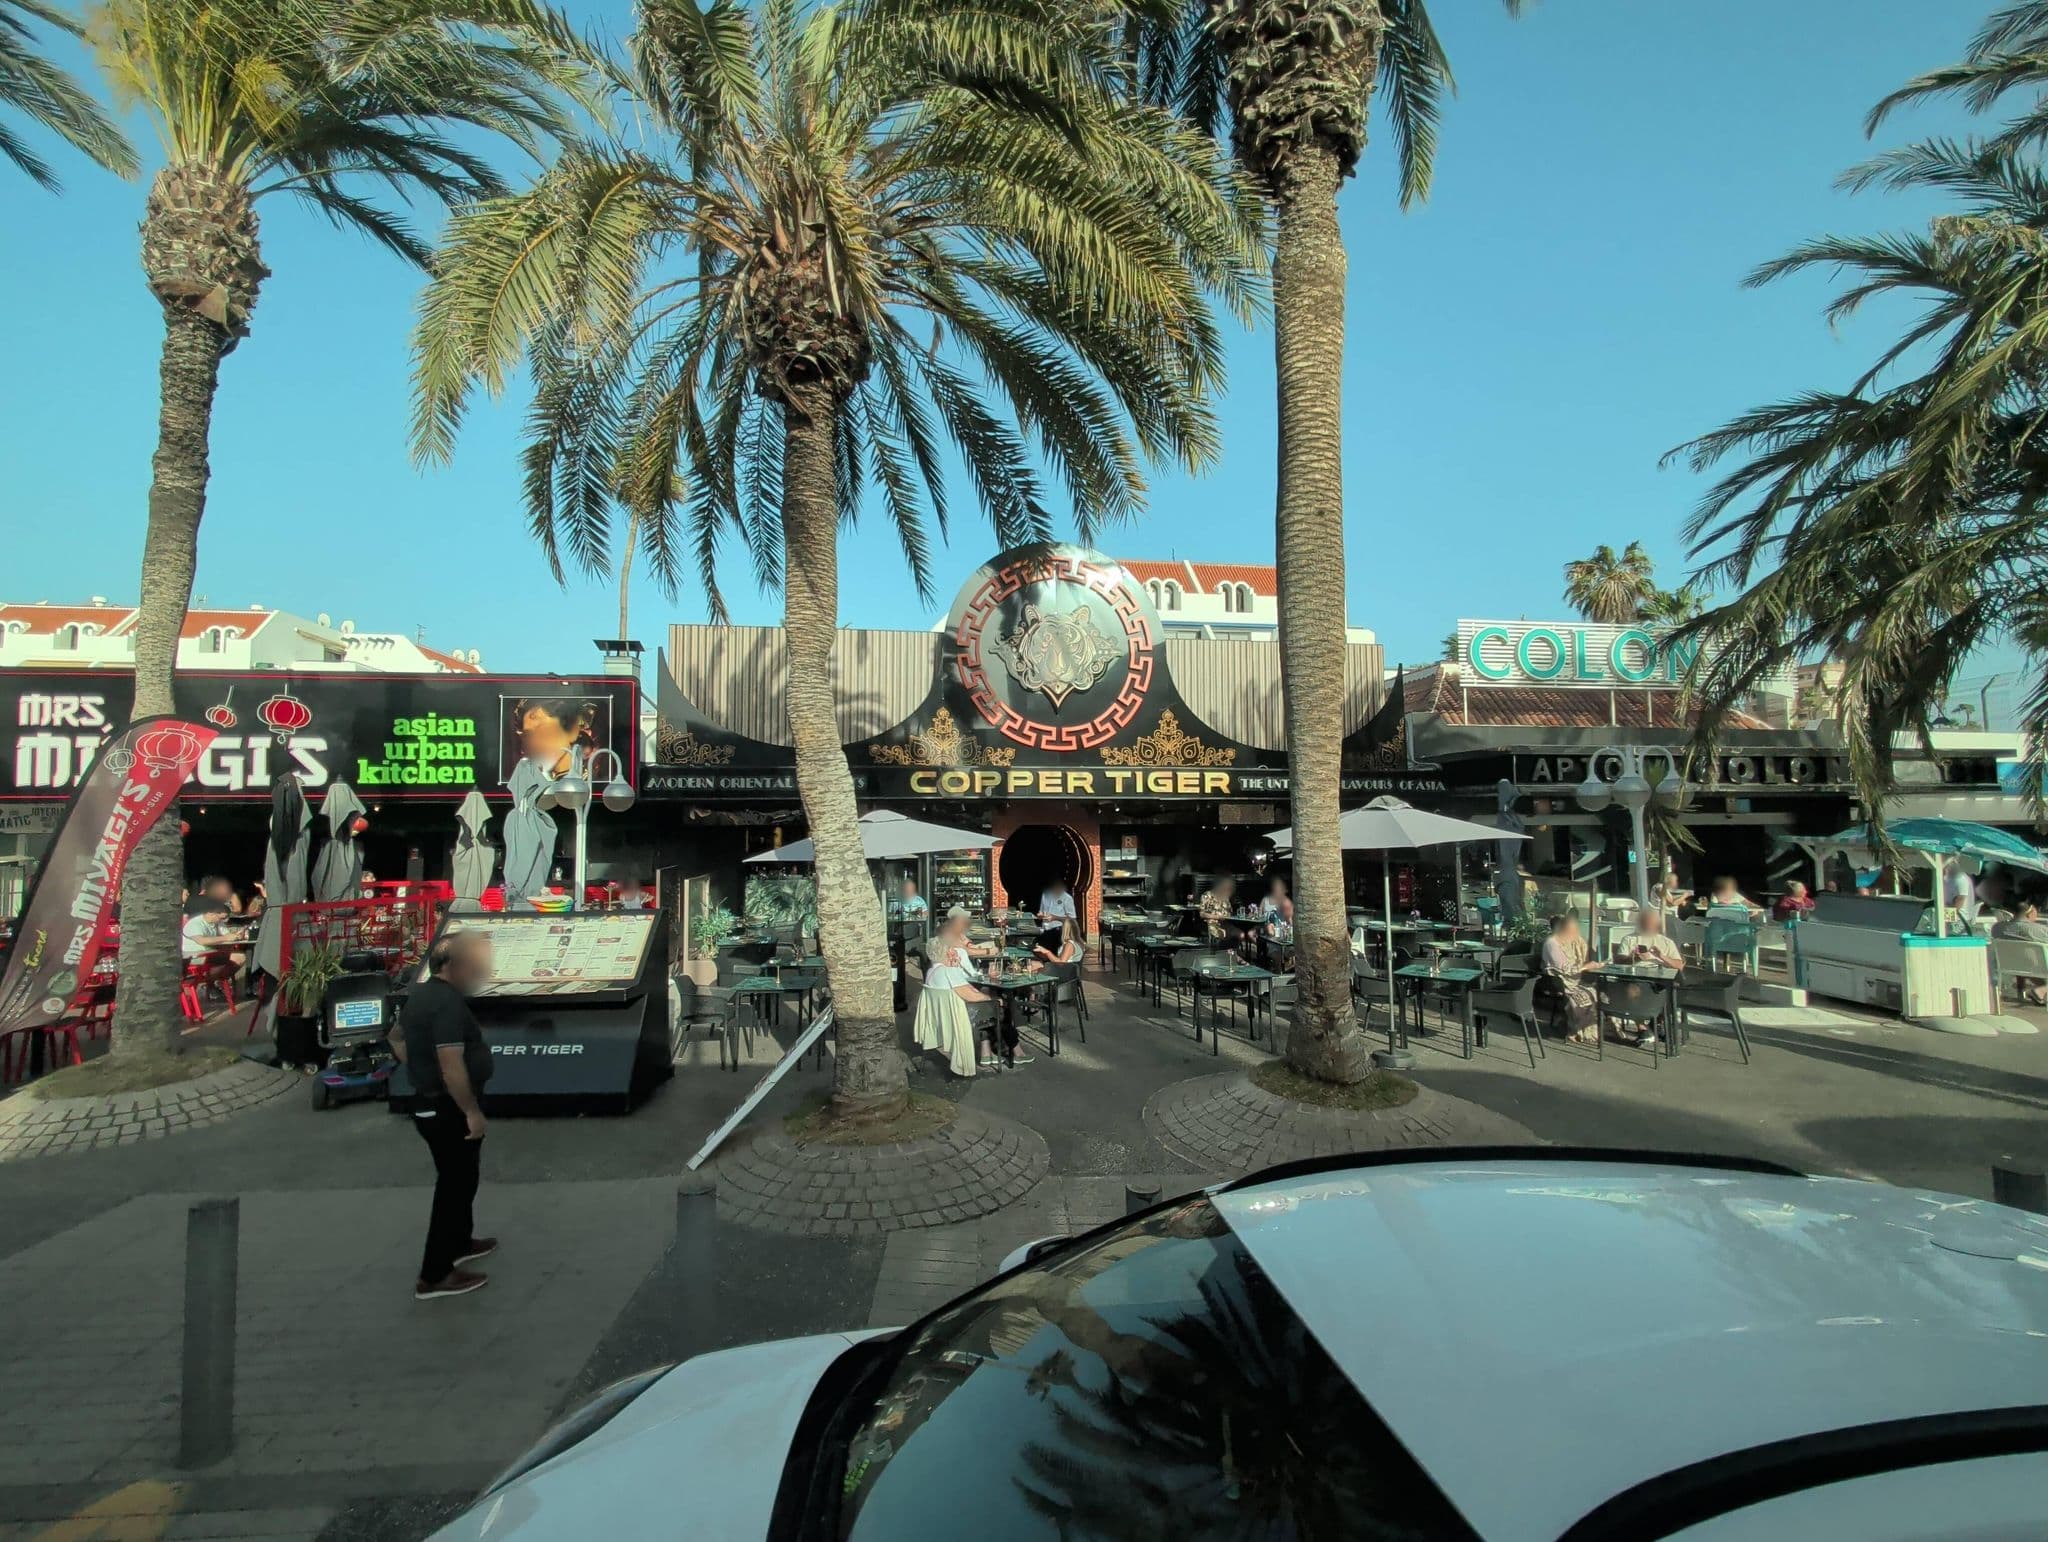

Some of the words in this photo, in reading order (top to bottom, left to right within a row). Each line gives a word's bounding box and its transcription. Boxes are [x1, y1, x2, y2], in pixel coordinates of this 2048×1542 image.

[1470, 623, 1702, 682] COLÓN
[393, 712, 475, 736] asian
[384, 736, 475, 760] urban
[357, 759, 475, 784] kitchen
[647, 776, 714, 789] MODERN
[720, 776, 793, 789] ORIENTAL
[910, 771, 1095, 794] COPPER
[1105, 771, 1230, 794] TIGER
[1239, 778, 1264, 790] THE
[1341, 779, 1393, 791] LAVOURS
[1400, 779, 1415, 791] OF
[490, 1046, 526, 1056] PER
[532, 1045, 585, 1056] TIGER
